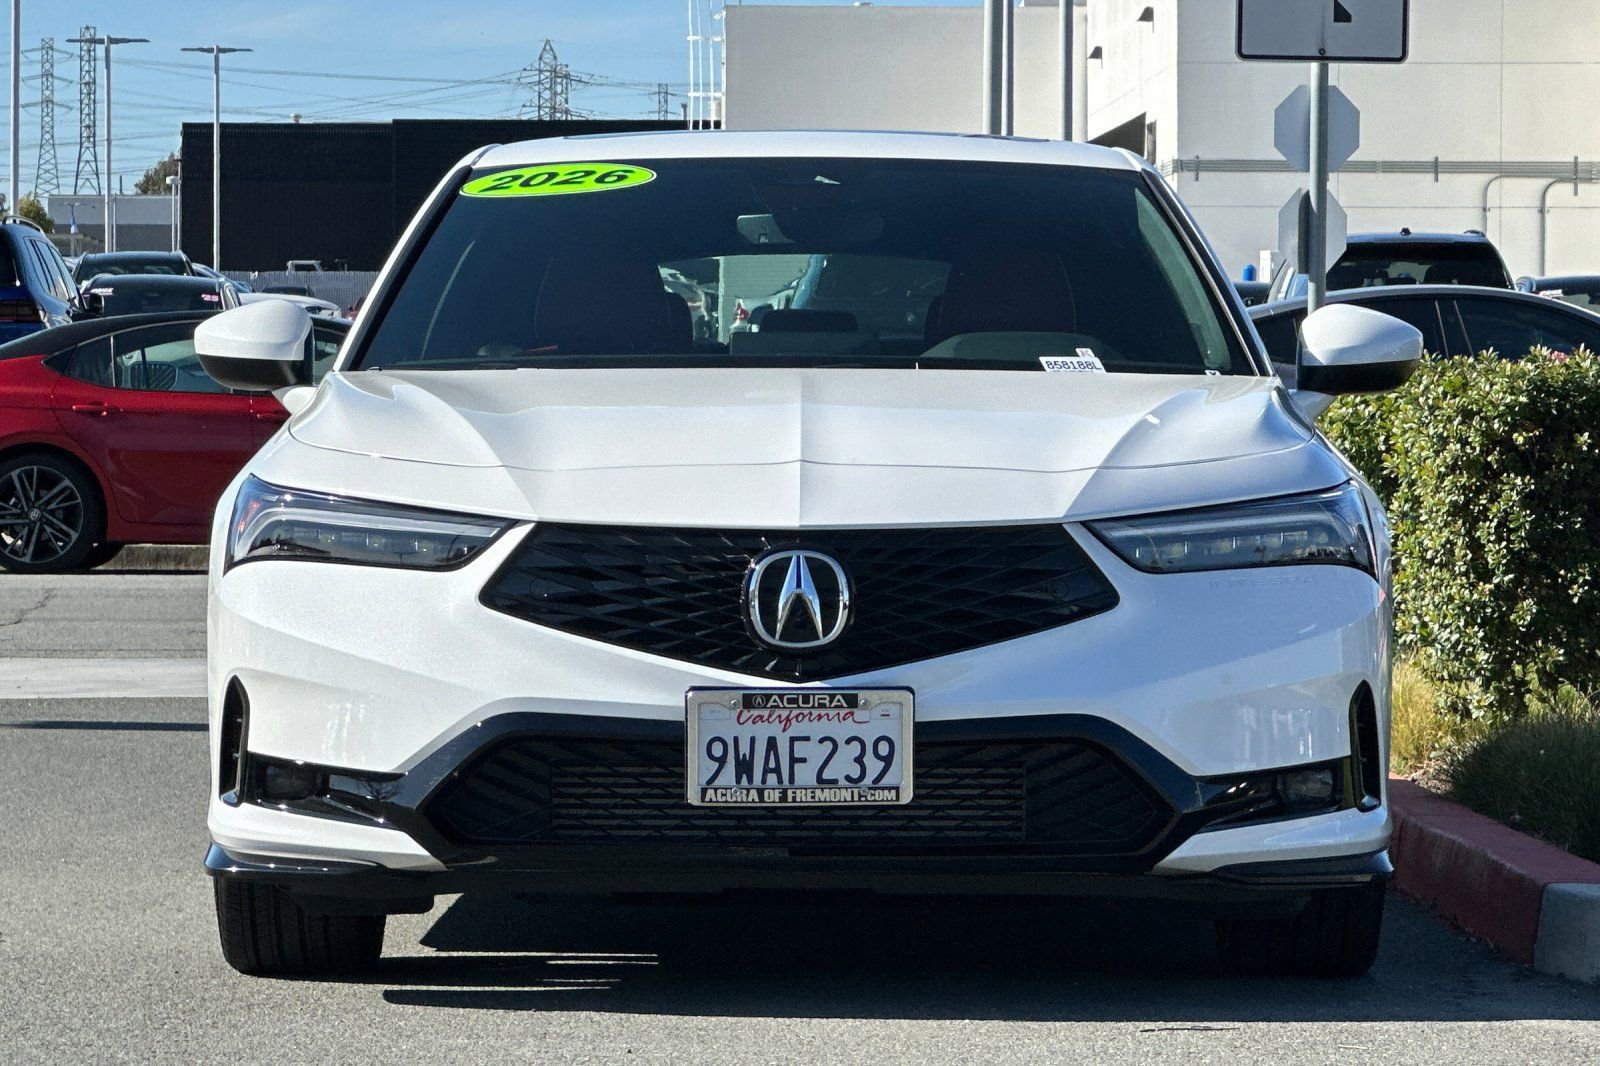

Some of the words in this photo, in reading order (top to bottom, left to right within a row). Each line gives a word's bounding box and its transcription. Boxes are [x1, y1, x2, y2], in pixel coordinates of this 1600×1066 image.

[478, 169, 636, 193] 2026
[1208, 575, 1317, 589] INTEGRA
[766, 694, 848, 708] ACURA
[736, 708, 870, 733] California
[705, 735, 896, 786] 9WAF239
[763, 787, 783, 802] OF
